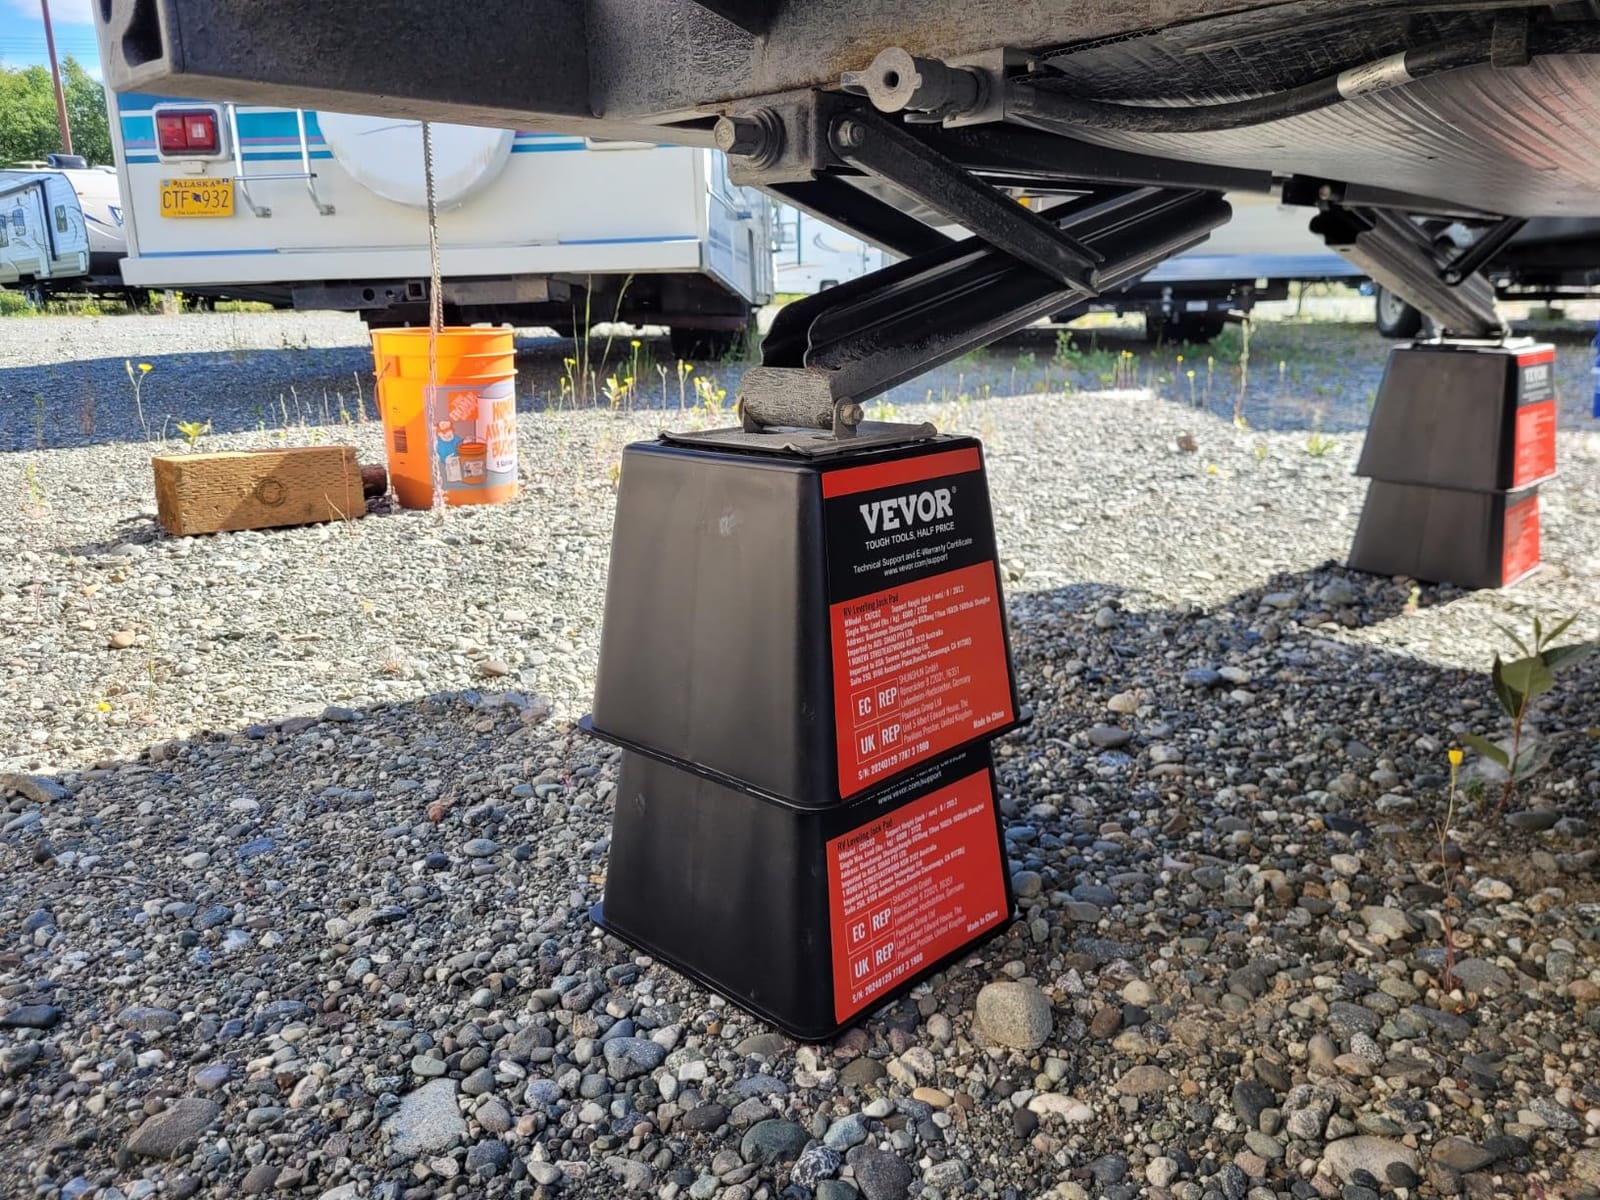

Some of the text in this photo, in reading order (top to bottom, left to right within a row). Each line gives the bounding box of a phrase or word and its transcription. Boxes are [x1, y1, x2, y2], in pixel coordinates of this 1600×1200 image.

[162, 190, 229, 209] CTF 932
[859, 488, 953, 534] VEVOR
[864, 521, 955, 550] TOUGH TOOLS, HALF PRICE
[853, 536, 972, 573] Technical Support and E-Warranty Certificate
[883, 553, 948, 577] www.vevor.com/support
[858, 695, 871, 716] EC
[878, 685, 897, 708] REP
[860, 732, 875, 755] UK
[881, 722, 900, 746] REP
[852, 920, 865, 943] EC
[872, 906, 891, 932] REP
[854, 955, 869, 979] UK
[875, 940, 894, 966] REP
